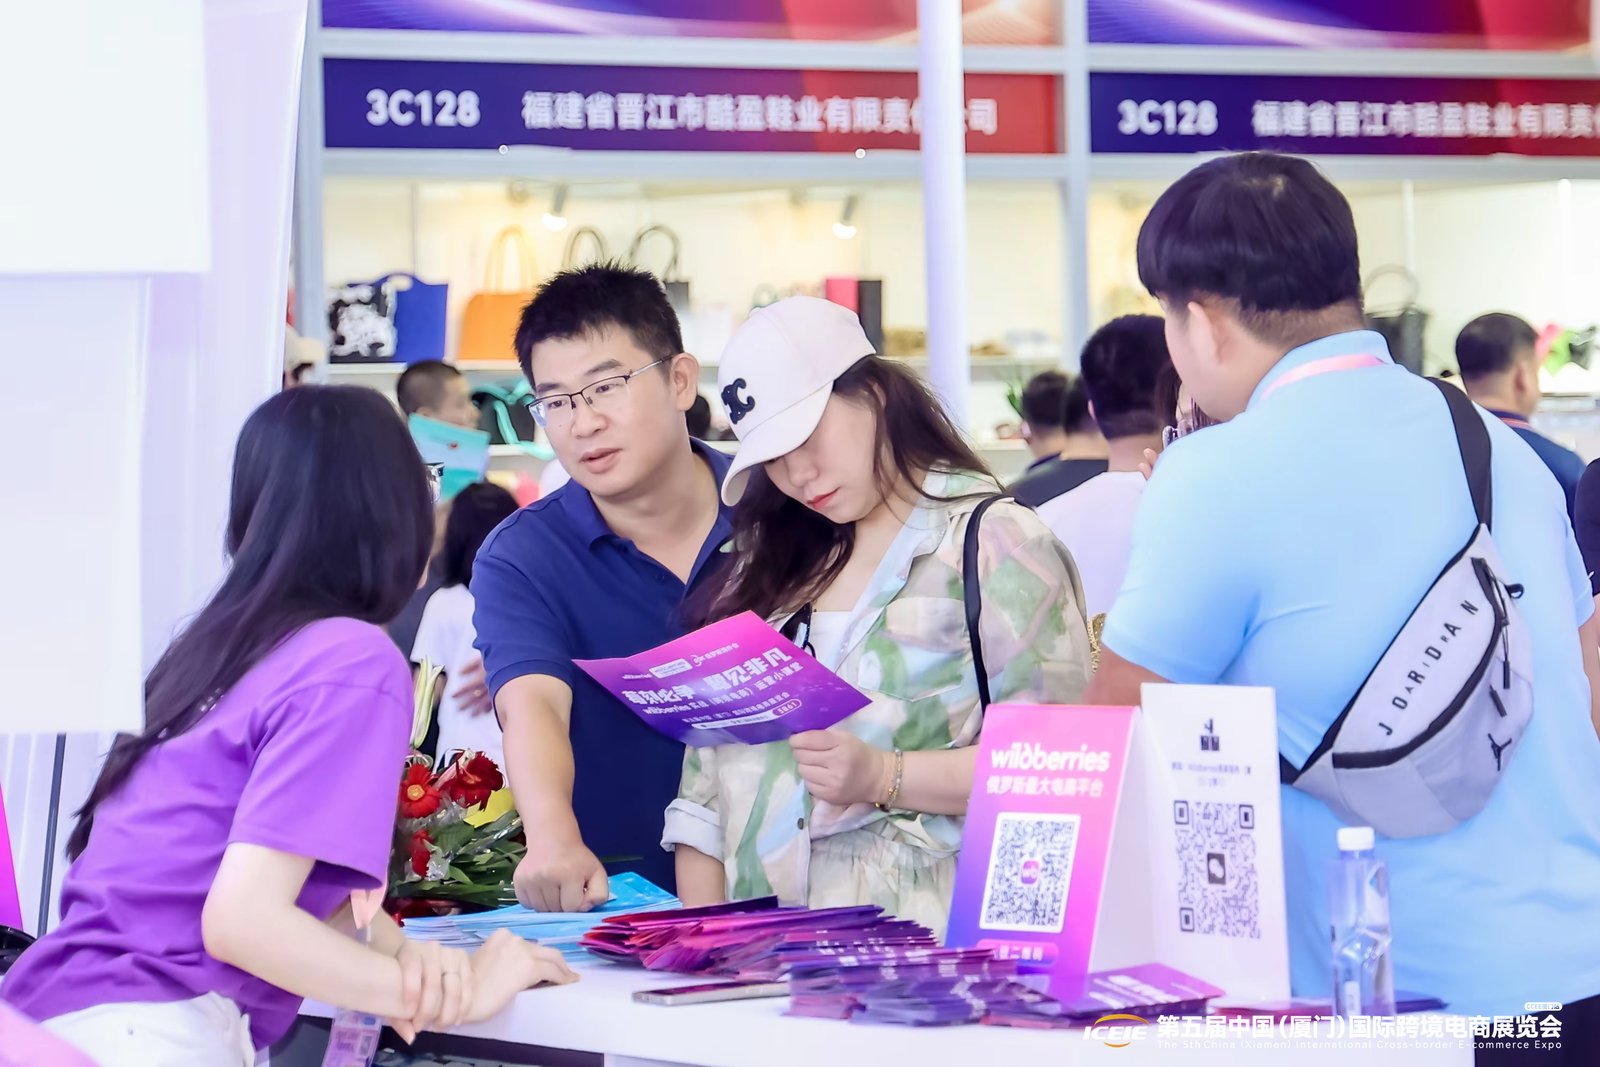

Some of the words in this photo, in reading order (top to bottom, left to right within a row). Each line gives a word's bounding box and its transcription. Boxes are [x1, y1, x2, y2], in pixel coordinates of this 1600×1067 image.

[365, 88, 481, 128] 3C128
[522, 90, 998, 135] 福建省晋江市酷盈鞋业有限责司
[1117, 98, 1219, 136] 3C128
[1252, 99, 1600, 138] 福建省晋江市酷盈鞋业有限责
[991, 742, 1111, 772] wildberries
